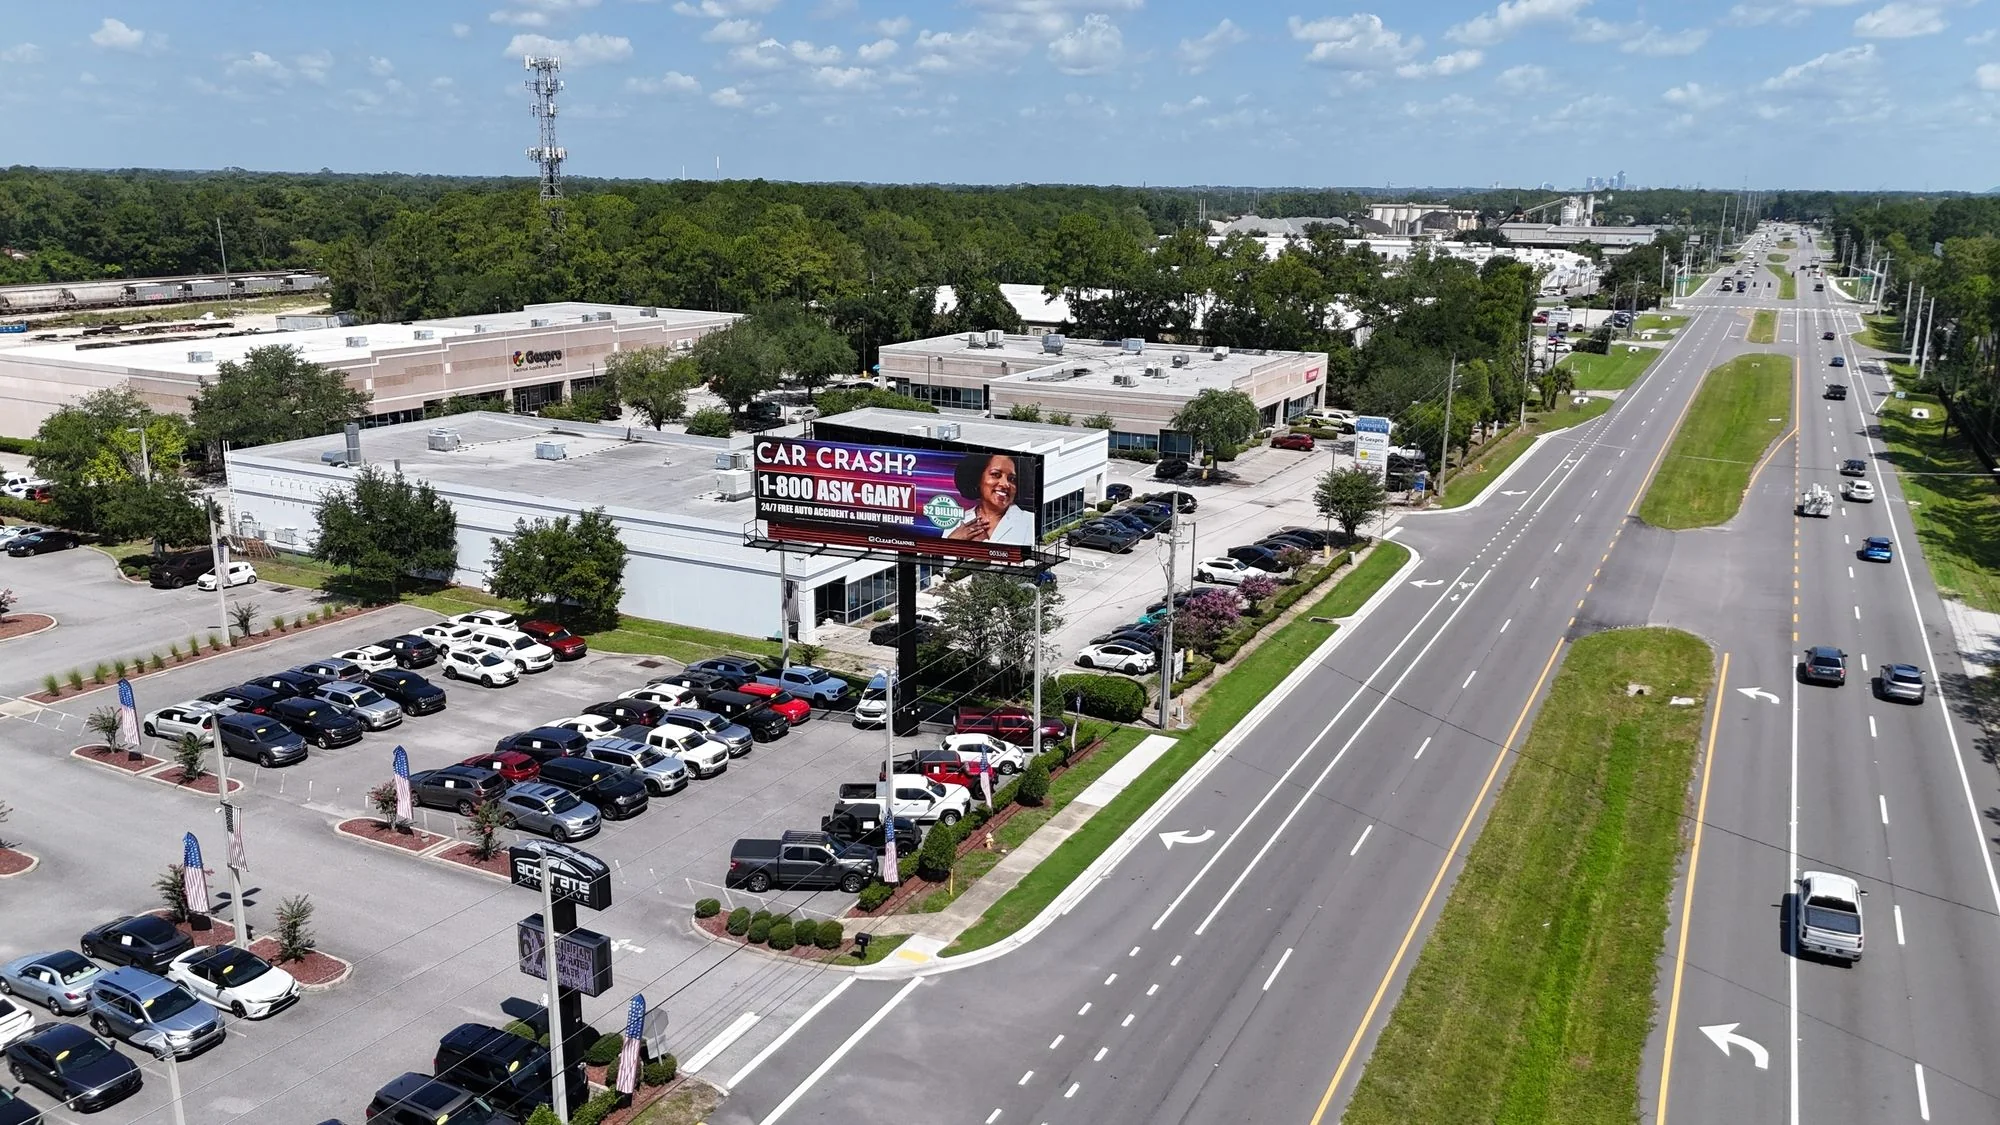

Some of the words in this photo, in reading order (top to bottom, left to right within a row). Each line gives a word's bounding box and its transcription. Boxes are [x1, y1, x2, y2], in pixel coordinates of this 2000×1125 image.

[526, 350, 562, 368] Gexpro
[756, 442, 807, 466] CAR
[816, 447, 917, 476] CRASH?
[759, 474, 814, 500] 1-800
[816, 479, 911, 509] ASK-GARY
[761, 502, 777, 512] 24/7
[778, 504, 794, 514] FREE
[794, 506, 813, 516] AUTO
[814, 507, 848, 519] ACCIDENT
[849, 512, 856, 520] &
[856, 512, 882, 523] INJURY
[882, 514, 915, 525] HELPLINE
[923, 505, 934, 515] $2
[934, 506, 964, 518] BILLION
[516, 861, 590, 894] accrate
[558, 964, 579, 977] EALER
